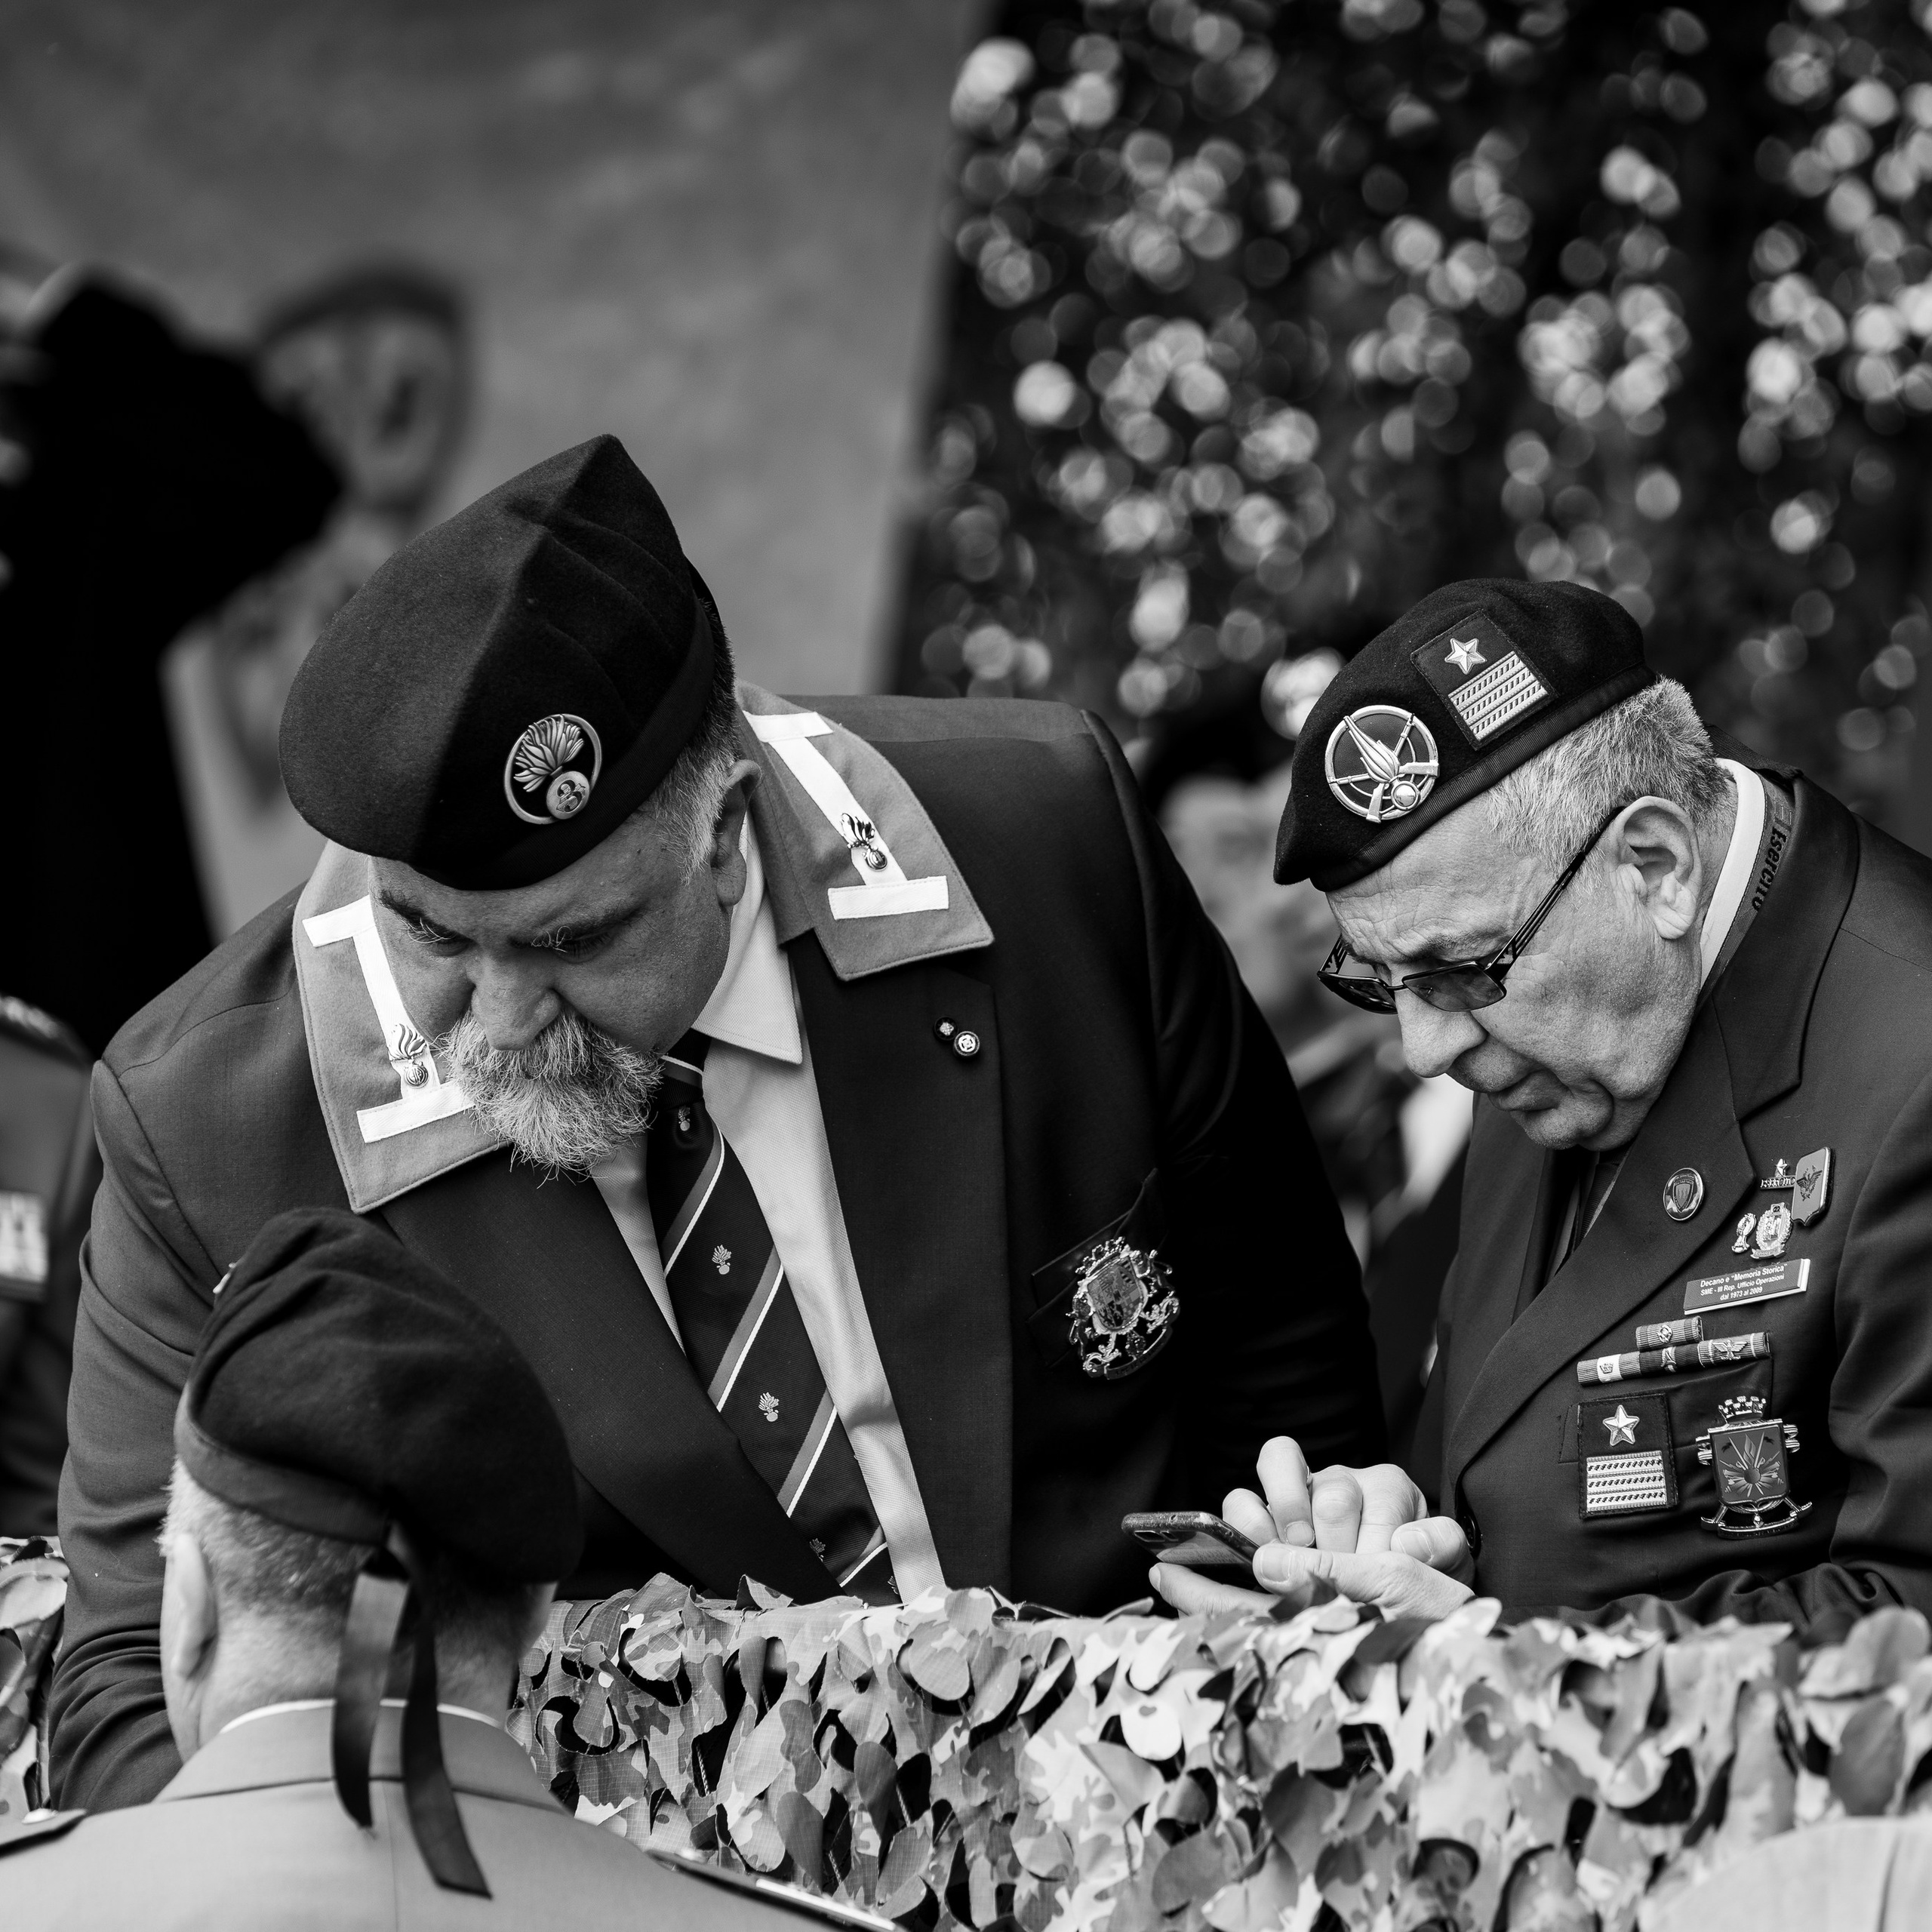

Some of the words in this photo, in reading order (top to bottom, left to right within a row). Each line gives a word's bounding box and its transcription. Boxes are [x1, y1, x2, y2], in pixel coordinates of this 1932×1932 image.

[1700, 1278, 1724, 1287] Decano
[1731, 1270, 1761, 1281] “Memoria
[1762, 1263, 1788, 1275] Storica”
[1700, 1287, 1713, 1296] SME
[1724, 1284, 1736, 1293] Rep.
[1737, 1280, 1755, 1289] Ufficio
[1755, 1274, 1785, 1285] Operazioni
[1720, 1293, 1729, 1301] dal
[1730, 1290, 1743, 1299] 1973
[1749, 1287, 1763, 1295] 2009
